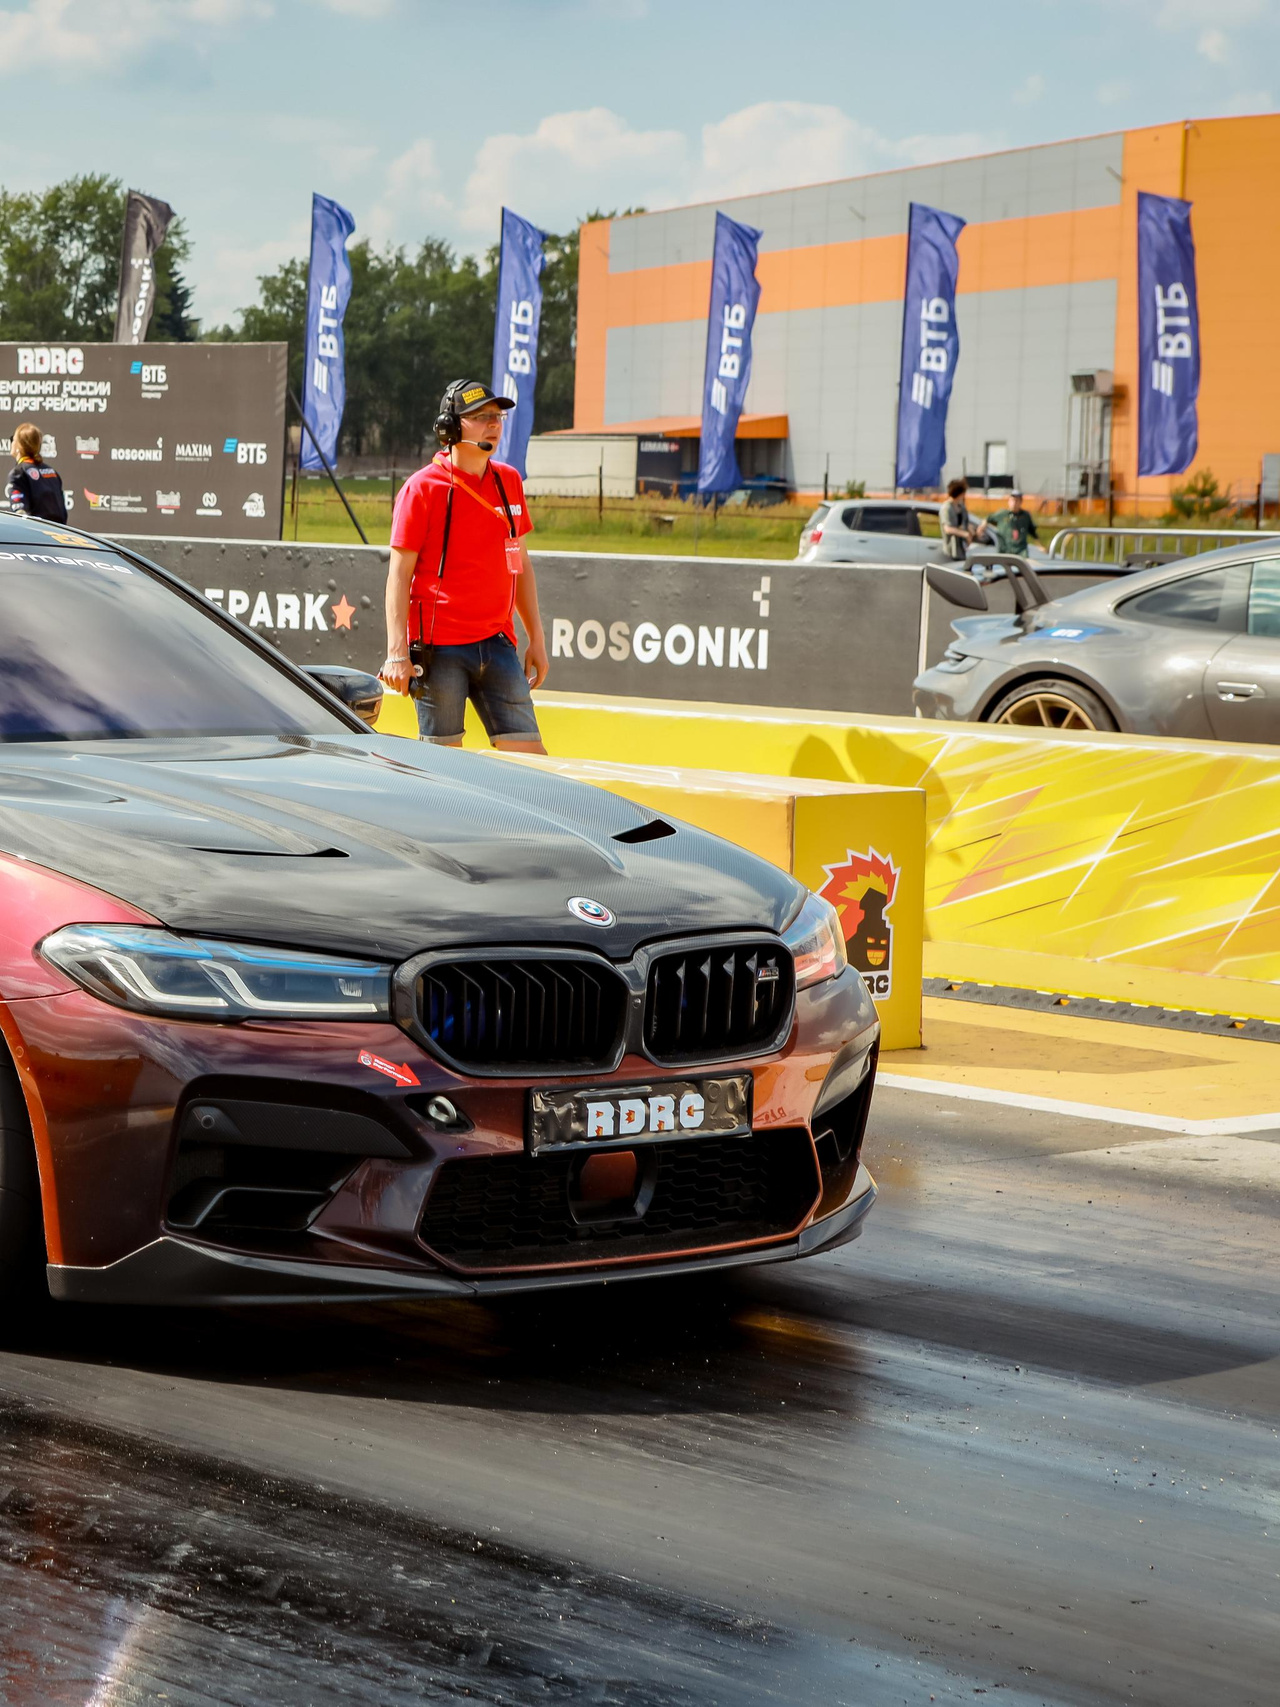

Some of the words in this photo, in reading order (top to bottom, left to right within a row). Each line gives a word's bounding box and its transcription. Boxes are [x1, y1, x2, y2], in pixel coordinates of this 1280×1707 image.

[318, 284, 339, 358] ВТБ
[508, 300, 533, 375] ВТБ
[920, 296, 949, 372] ВТБ
[1155, 282, 1192, 358] ВТБ
[718, 303, 746, 379] ВТБ
[17, 347, 84, 375] RDRC
[141, 365, 167, 383] ВТБ
[13, 395, 108, 413] ДРЭГ-РЕЙСИНГУ
[62, 381, 111, 396] РОССИИ
[111, 448, 162, 461] ROSGONKI
[175, 443, 212, 457] MAXIM
[237, 443, 267, 464] ВТБ
[204, 588, 329, 632] EPARK
[551, 617, 769, 671] ROSGONKI
[867, 975, 889, 994] RC
[586, 1093, 705, 1138] RDRC
